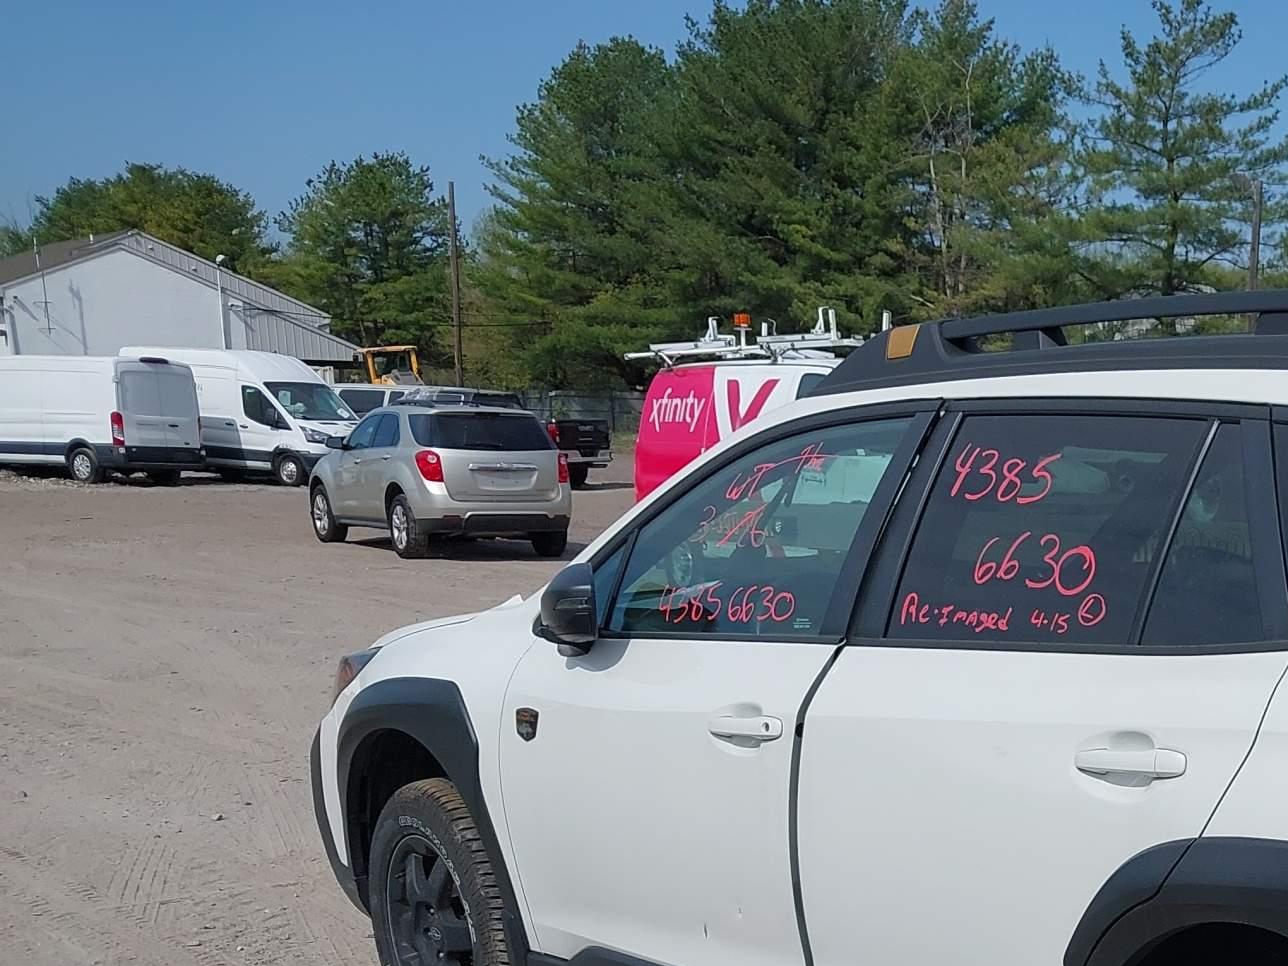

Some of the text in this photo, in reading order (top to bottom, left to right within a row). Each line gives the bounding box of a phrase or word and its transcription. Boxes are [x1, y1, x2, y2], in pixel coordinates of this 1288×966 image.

[649, 387, 706, 432] xfinity
[951, 442, 1063, 504] 4385
[974, 531, 1096, 596] 6630
